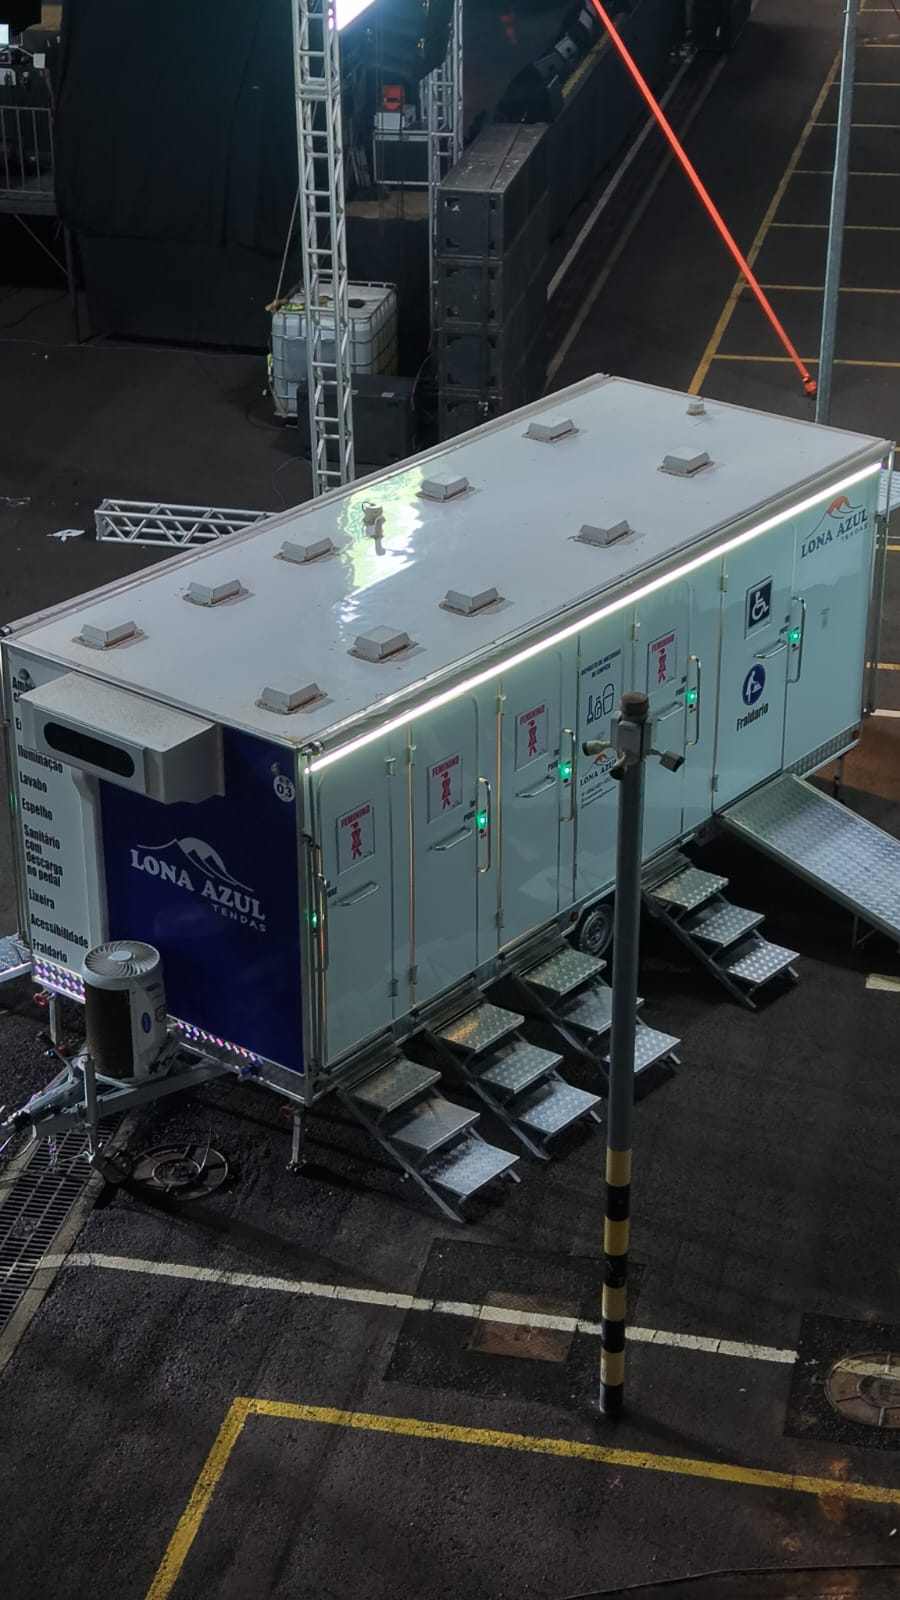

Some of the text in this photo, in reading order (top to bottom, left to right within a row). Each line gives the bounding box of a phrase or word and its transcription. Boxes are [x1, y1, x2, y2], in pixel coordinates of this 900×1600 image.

[801, 509, 868, 558] LONA AZUL
[736, 703, 769, 732] Fraldario
[20, 771, 47, 793] Lavabo
[276, 783, 293, 798] 03
[580, 770, 599, 787] LONA
[22, 797, 53, 821] Espelho
[23, 823, 60, 851] Sanitário
[25, 838, 42, 855] com
[26, 850, 63, 877] descarga
[27, 864, 60, 888] no pedal
[130, 849, 266, 921] LONA AZUL
[29, 887, 55, 910] Lixeira
[31, 913, 89, 948] Acessibilidade
[210, 903, 267, 933] TENDAS
[33, 938, 68, 963] Fraldario
